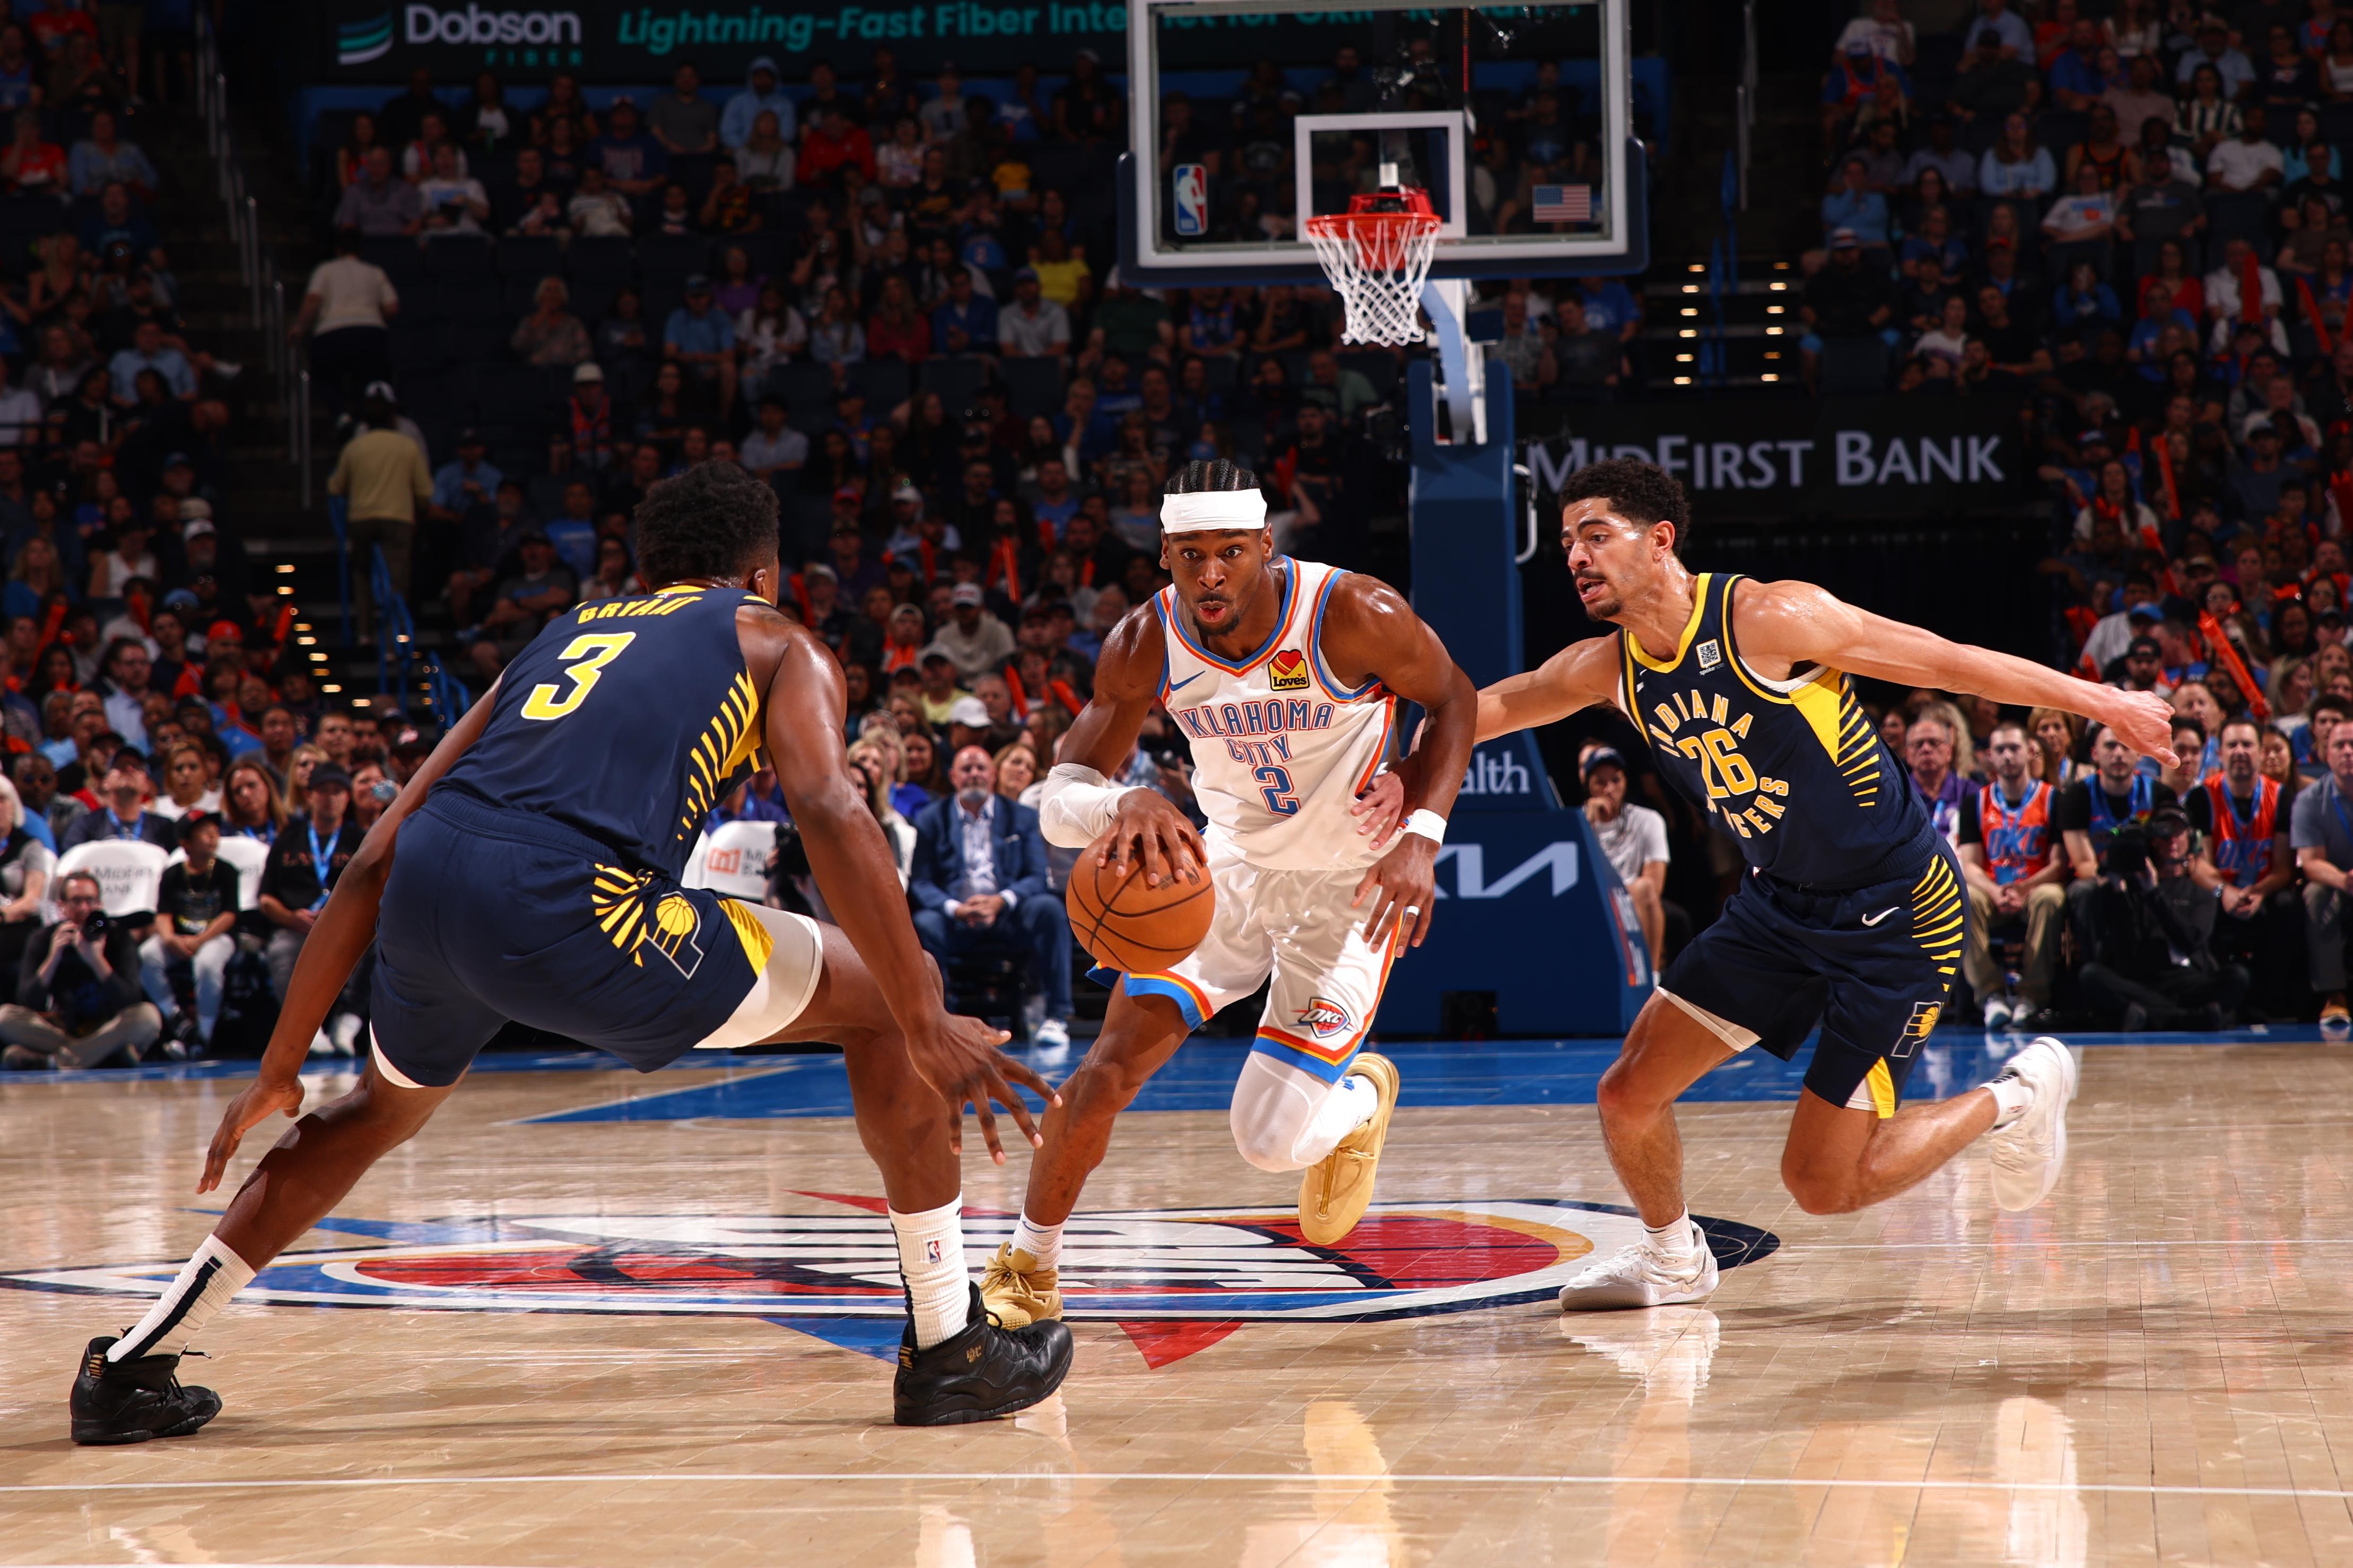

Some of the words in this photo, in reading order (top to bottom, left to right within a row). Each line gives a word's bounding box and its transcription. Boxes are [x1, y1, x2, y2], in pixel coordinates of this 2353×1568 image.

[405, 2, 581, 45] Dobson
[616, 4, 926, 56] Lightning-Fast
[935, 2, 1040, 38] Fiber
[485, 49, 582, 66] FIBER
[1835, 430, 2006, 487] BANK
[520, 632, 637, 720] 3
[1699, 662, 1725, 676] spokenote
[1223, 733, 1293, 766] CITY
[1649, 689, 1755, 758] INDIANA
[1676, 728, 1757, 799] 26
[1251, 765, 1301, 818] 2
[1298, 1008, 1343, 1024] OKC
